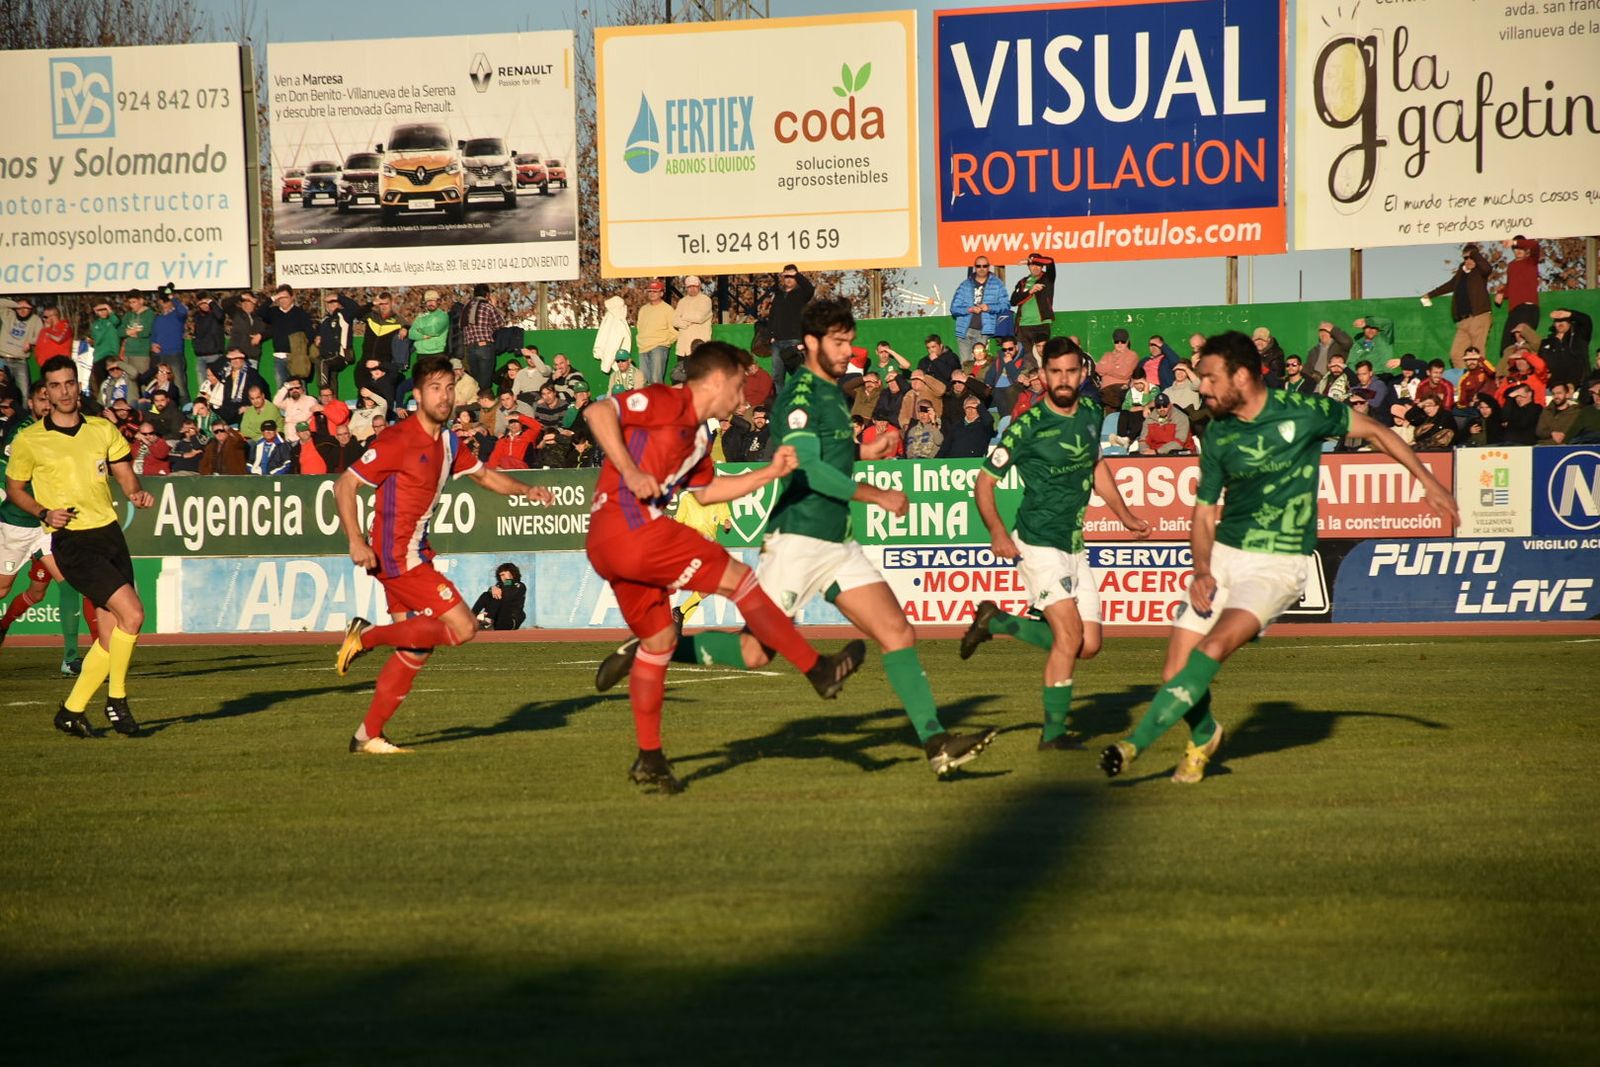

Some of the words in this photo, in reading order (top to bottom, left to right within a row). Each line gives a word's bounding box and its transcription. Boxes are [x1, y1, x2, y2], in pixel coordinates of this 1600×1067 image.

[1505, 3, 1539, 17] avda.
[1544, 1, 1565, 14] san
[1499, 24, 1564, 41] villanueva
[1569, 21, 1585, 36] de
[1589, 20, 1600, 34] la
[1392, 25, 1449, 92] la
[274, 75, 293, 87] Ven
[294, 76, 300, 86] a
[302, 73, 343, 86] Marcesa
[498, 65, 553, 77] RENAULT
[498, 79, 520, 87] Passion
[531, 77, 541, 85] life
[950, 26, 1266, 129] VISUAL
[117, 90, 151, 111] 924
[157, 88, 190, 110] 842
[196, 88, 230, 109] 073
[275, 93, 288, 103] en
[289, 90, 308, 102] Don
[311, 88, 342, 102] Benito
[346, 87, 396, 100] Villanueva
[398, 85, 410, 98] de
[412, 84, 420, 97] la
[422, 84, 456, 97] Serena
[275, 109, 282, 120] y
[283, 105, 325, 118] descubre
[328, 104, 336, 116] la
[338, 103, 383, 116] renovada
[384, 101, 412, 115] Gama
[414, 99, 454, 113] Renault.
[774, 95, 885, 144] coda
[665, 95, 756, 154] FERTIEX
[48, 155, 64, 185] y
[73, 144, 228, 177] Solomando
[665, 157, 707, 175] ABONOS
[708, 153, 756, 175] LÍQUIDOS
[796, 156, 871, 171] soluciones
[952, 138, 1266, 196] ROTULACION
[778, 171, 889, 190] agrosostenibles
[0, 191, 230, 216] otora-constructora
[1384, 194, 1398, 212] El
[1403, 193, 1442, 211] mundo
[1449, 195, 1477, 209] tiene
[1483, 188, 1535, 206] muchas
[1539, 189, 1579, 204] cosas
[961, 219, 1262, 253] www.visualrotulos.com
[1398, 223, 1412, 235] no
[1417, 221, 1431, 234] te
[1437, 216, 1485, 237] pierdas
[1490, 216, 1534, 234] ninguna
[678, 233, 710, 254] Tel.
[716, 231, 752, 253] 924
[758, 231, 780, 251] 81
[788, 229, 811, 250] 16
[816, 228, 840, 249] 59
[85, 259, 150, 287] para
[161, 252, 229, 279] vivir
[281, 263, 320, 276] MARCESA
[321, 262, 365, 276] SERVICIOS,
[366, 262, 382, 274] S.A.
[383, 261, 403, 273] Avda.
[404, 261, 425, 275] Vegas
[471, 258, 486, 270] 924
[488, 258, 497, 270] 81
[499, 257, 508, 270] 04
[522, 256, 540, 269] DON
[541, 255, 569, 268] BENITO
[850, 464, 902, 492] cios
[154, 481, 303, 551] Agencia
[497, 514, 590, 536] INVERSIONE
[867, 501, 968, 541] REINA
[1328, 515, 1342, 530] la
[1345, 513, 1442, 530] construcción
[1523, 540, 1578, 551] VIRGILIO
[1368, 541, 1506, 577] PUNTO
[1455, 578, 1594, 614] LLAVE
[902, 600, 1030, 622] ALVAEZ
